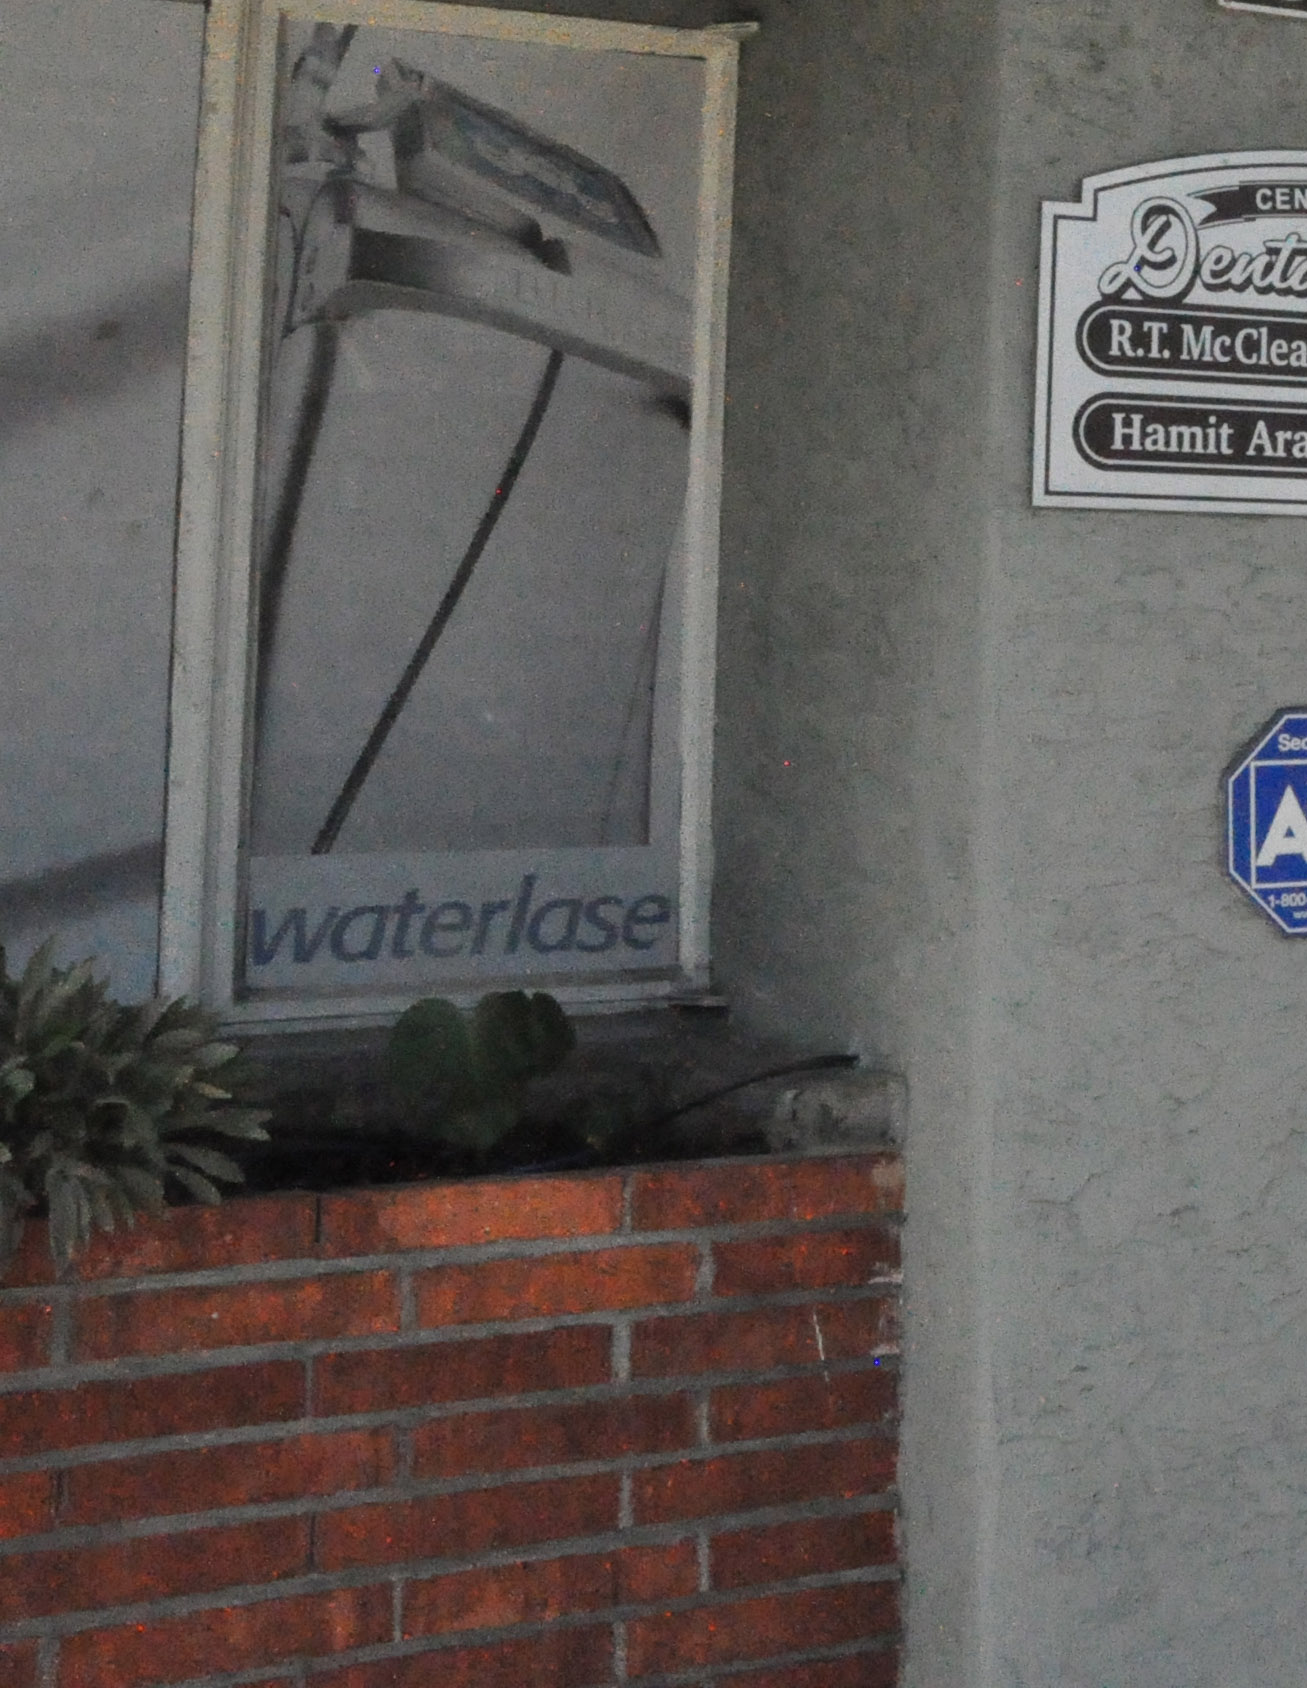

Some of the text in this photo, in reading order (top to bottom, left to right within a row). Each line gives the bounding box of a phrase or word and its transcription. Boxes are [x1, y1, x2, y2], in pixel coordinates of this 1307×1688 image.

[1108, 318, 1171, 359] R.T.
[1110, 412, 1235, 455] Hamit
[250, 873, 672, 967] waterlase
